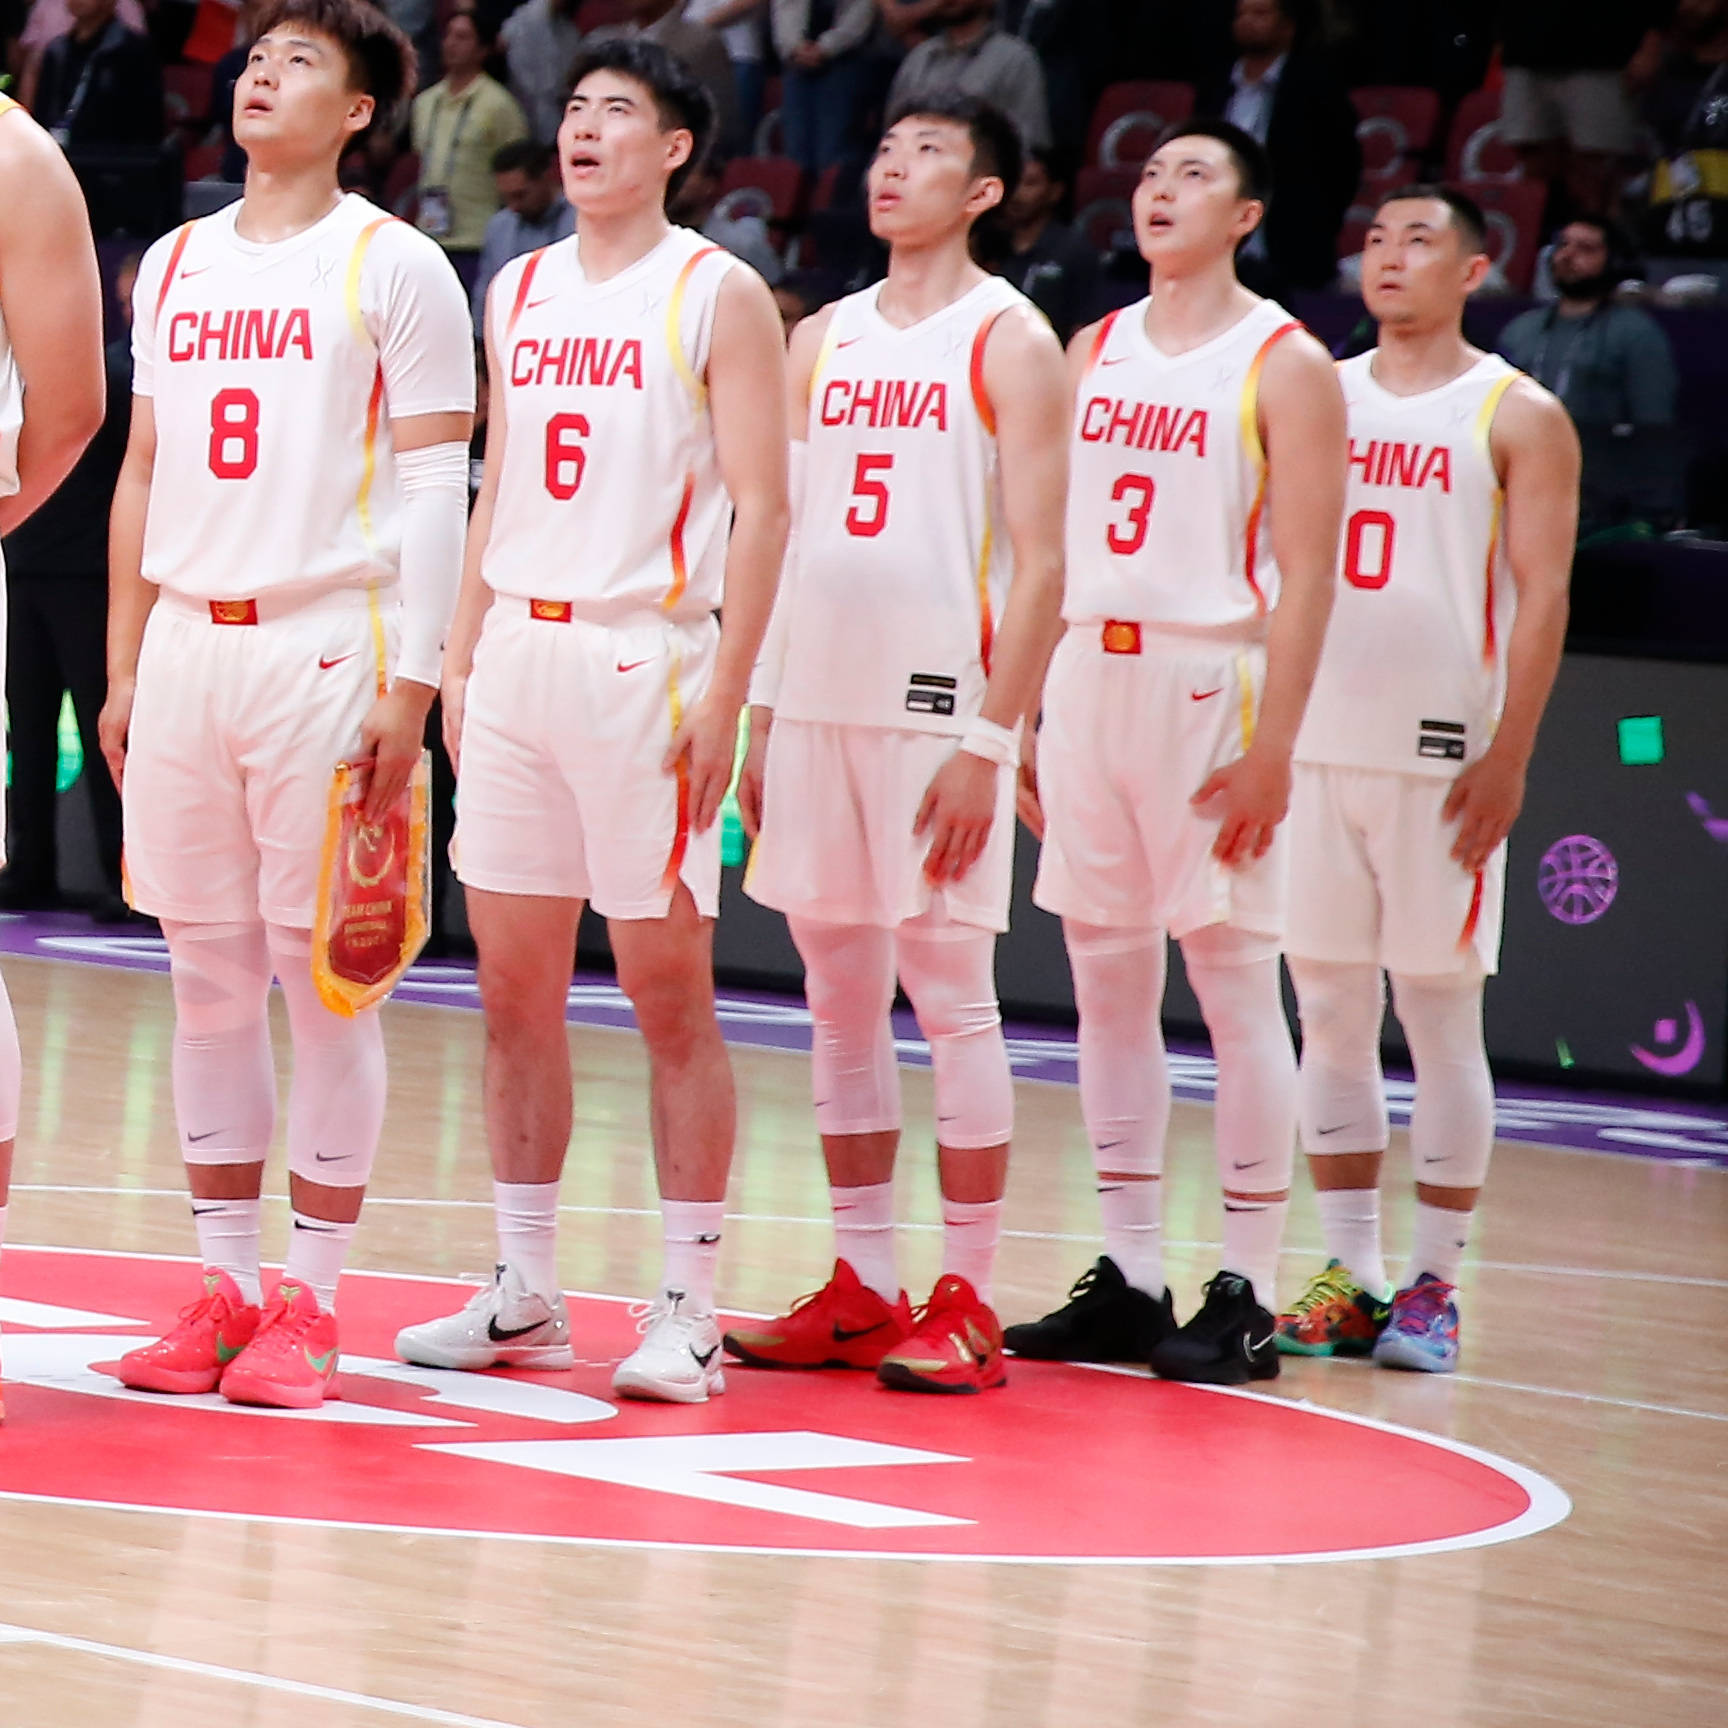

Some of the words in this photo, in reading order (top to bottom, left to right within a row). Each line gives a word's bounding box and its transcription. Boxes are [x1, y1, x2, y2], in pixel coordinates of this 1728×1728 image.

[168, 308, 314, 363] CHINA
[511, 337, 643, 390] CHINA
[208, 387, 260, 480] 8
[821, 380, 947, 432] CHINA
[1080, 396, 1209, 458] CHINA
[544, 412, 591, 501] 6
[1347, 438, 1452, 494] HINA
[844, 453, 894, 538] 5
[1106, 472, 1156, 556] 3
[1345, 508, 1396, 590] 0
